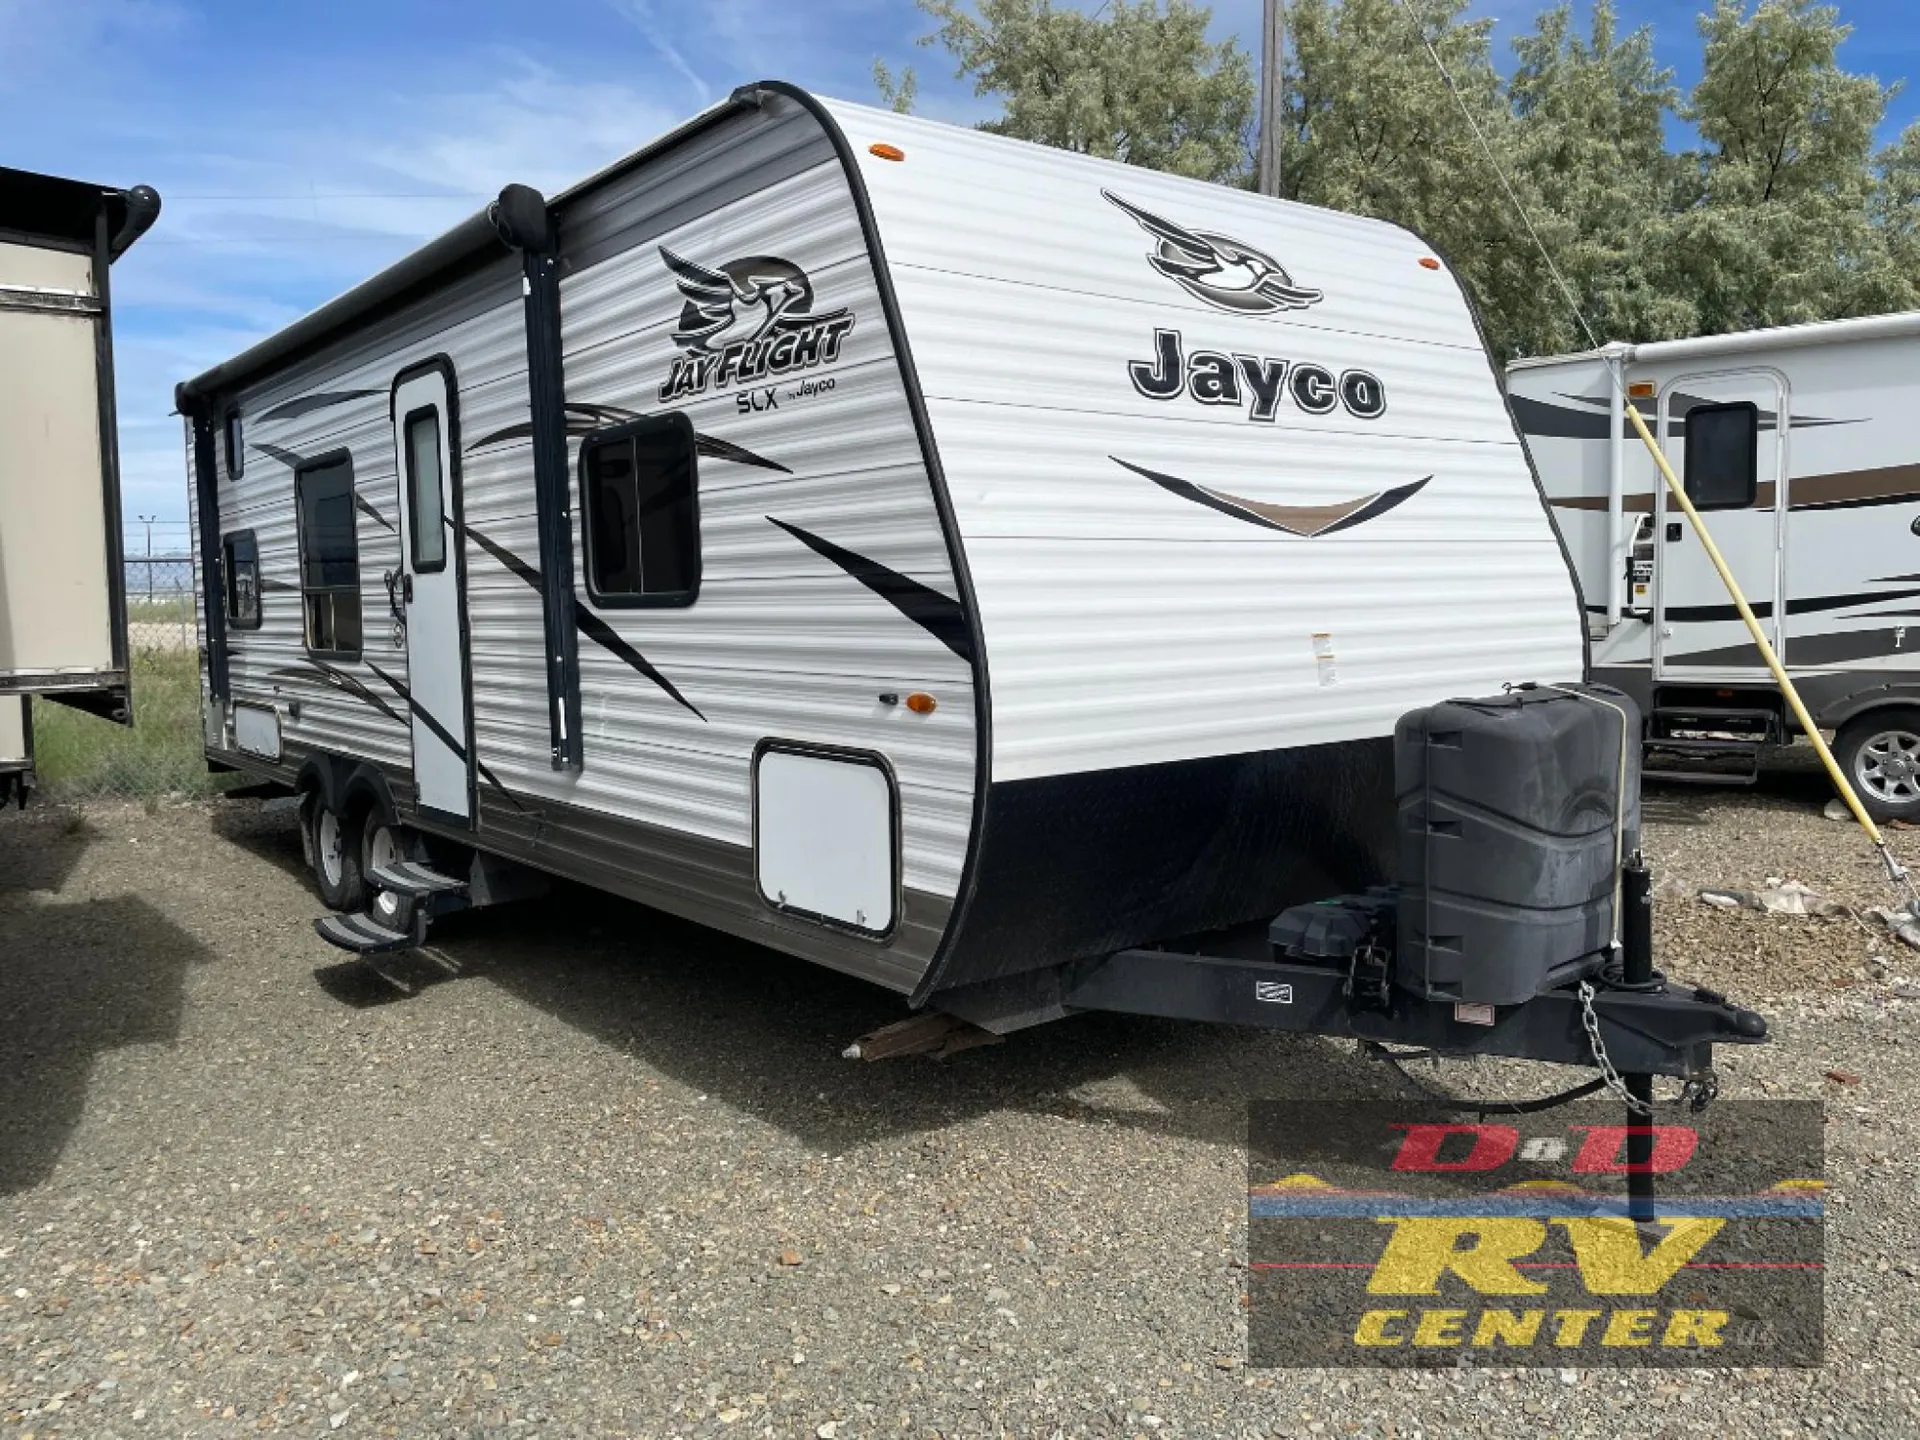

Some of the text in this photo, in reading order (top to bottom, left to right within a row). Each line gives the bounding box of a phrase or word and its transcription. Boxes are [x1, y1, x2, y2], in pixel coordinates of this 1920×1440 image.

[657, 313, 856, 403] JAY FLIGHT
[736, 387, 779, 415] SLX
[796, 378, 836, 399] Jayco
[1128, 327, 1387, 422] Jayco
